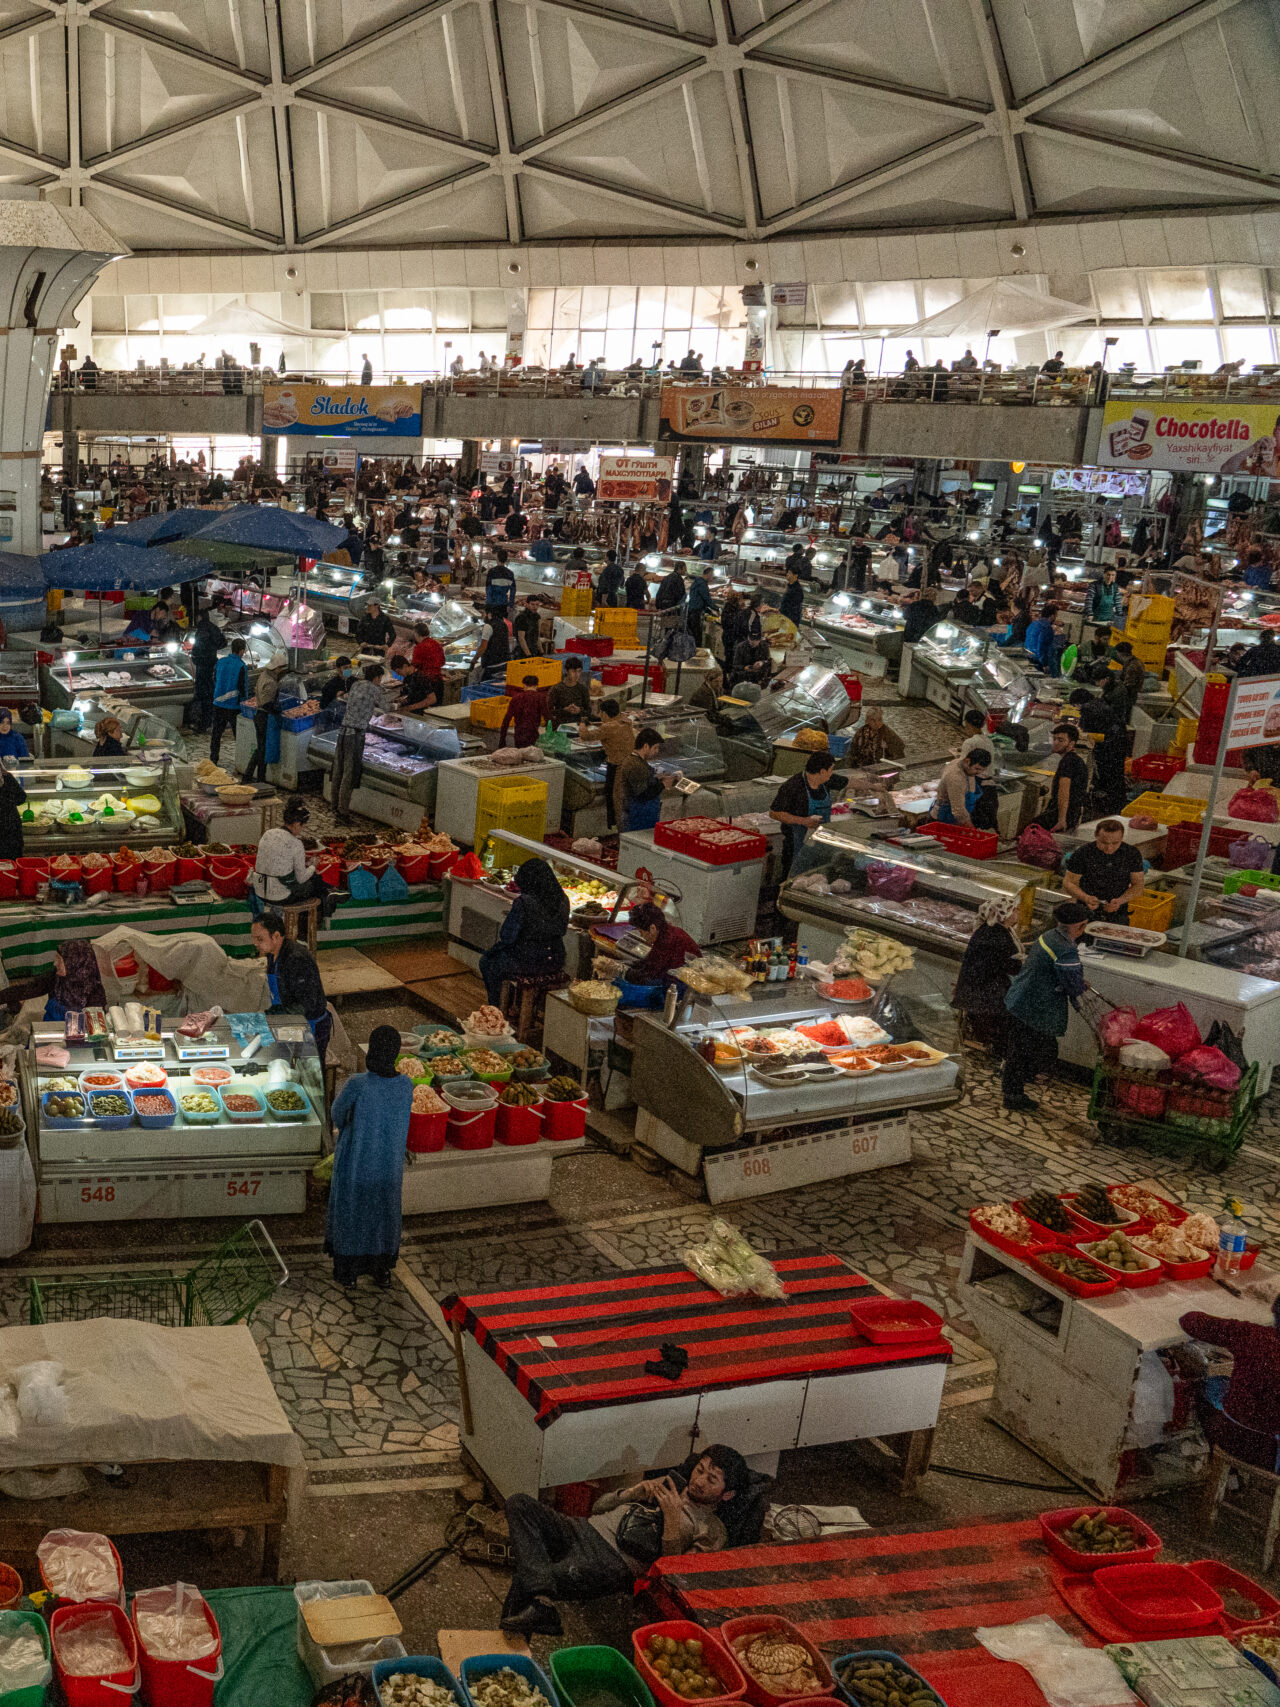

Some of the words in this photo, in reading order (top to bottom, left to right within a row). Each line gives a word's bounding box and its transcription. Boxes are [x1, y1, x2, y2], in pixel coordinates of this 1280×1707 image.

[310, 396, 370, 416] Sladok
[754, 419, 778, 430] BILAN
[1155, 416, 1250, 440] Chocotella
[852, 1135, 878, 1154] 607
[743, 1158, 771, 1177] 608
[81, 1186, 115, 1203] 548
[227, 1180, 261, 1197] 547
